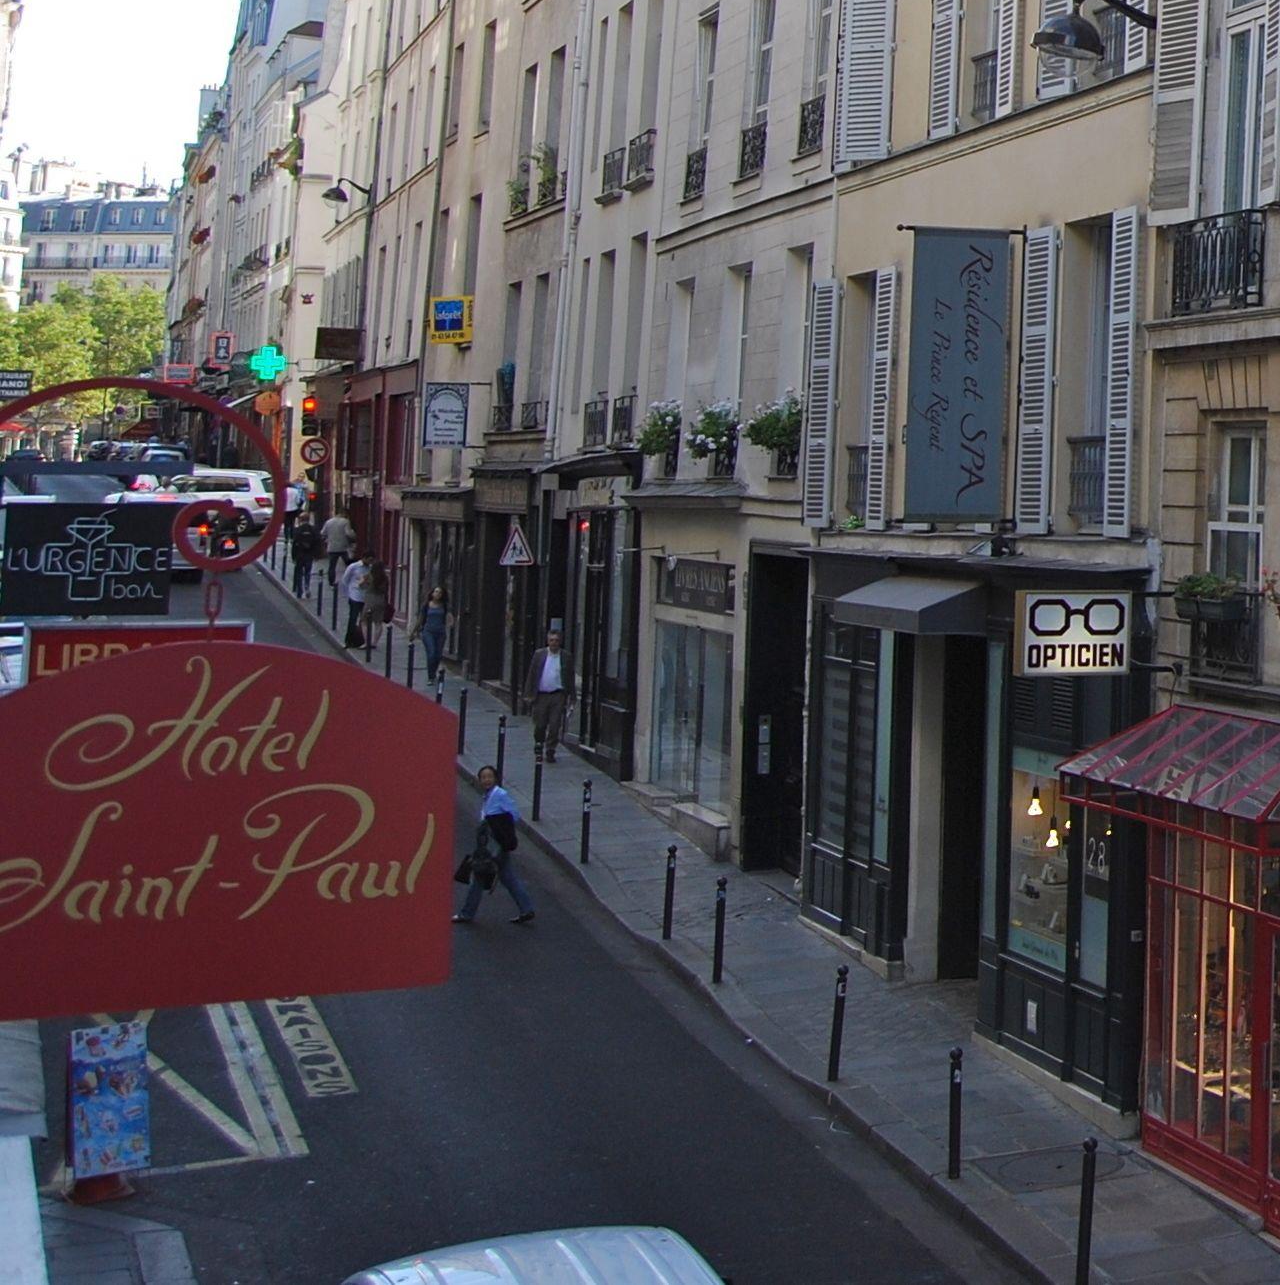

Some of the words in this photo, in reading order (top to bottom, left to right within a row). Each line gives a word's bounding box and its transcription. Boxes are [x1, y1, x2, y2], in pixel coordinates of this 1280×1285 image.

[933, 297, 953, 321] Le
[959, 244, 1004, 365] Résidence
[929, 330, 952, 384] Prince
[963, 375, 983, 402] et
[910, 392, 950, 453] Régent
[956, 413, 988, 508] SPA
[7, 546, 170, 573] L'URGENCE
[110, 580, 164, 599] bar
[1027, 643, 1125, 668] OPTICIEN
[1086, 836, 1107, 873] 28
